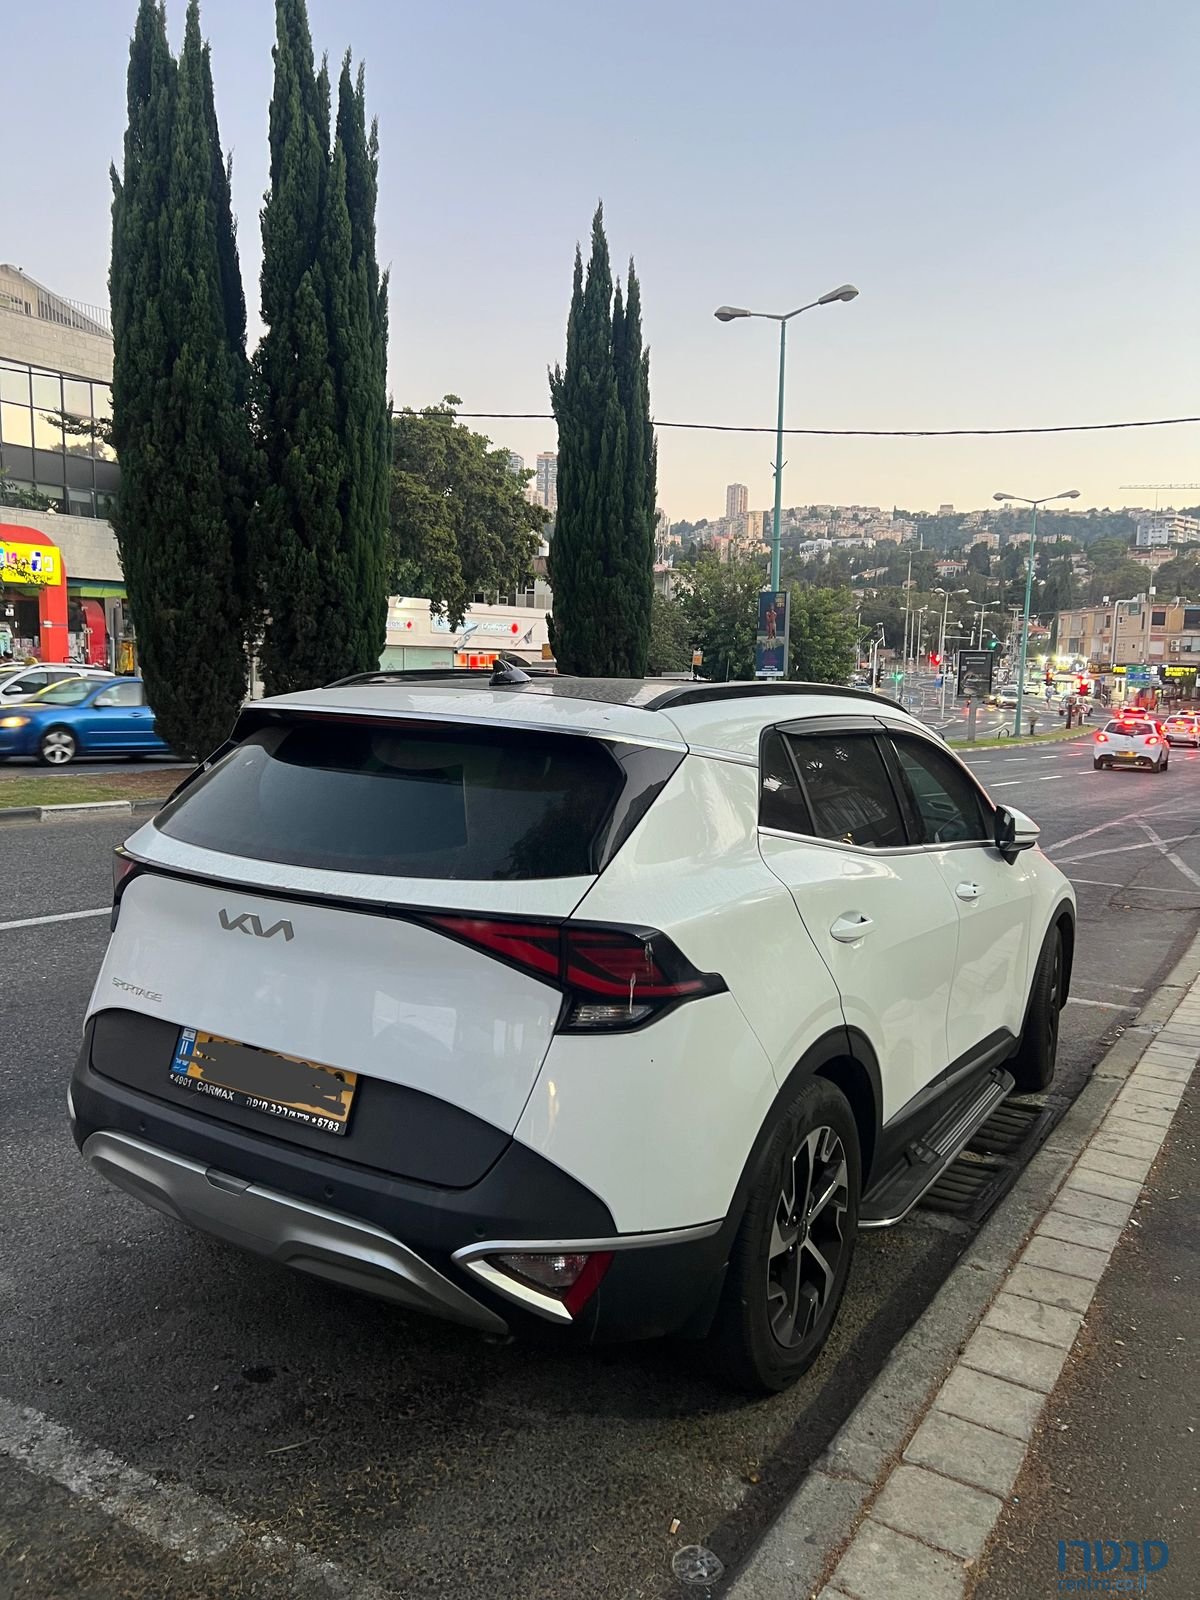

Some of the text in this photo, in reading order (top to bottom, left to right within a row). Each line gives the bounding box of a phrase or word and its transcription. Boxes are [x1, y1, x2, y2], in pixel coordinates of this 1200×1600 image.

[112, 977, 163, 1002] SPORTAGE
[196, 1081, 235, 1101] CARMAX
[246, 1097, 268, 1111] חיפה
[270, 1103, 288, 1117] רכב
